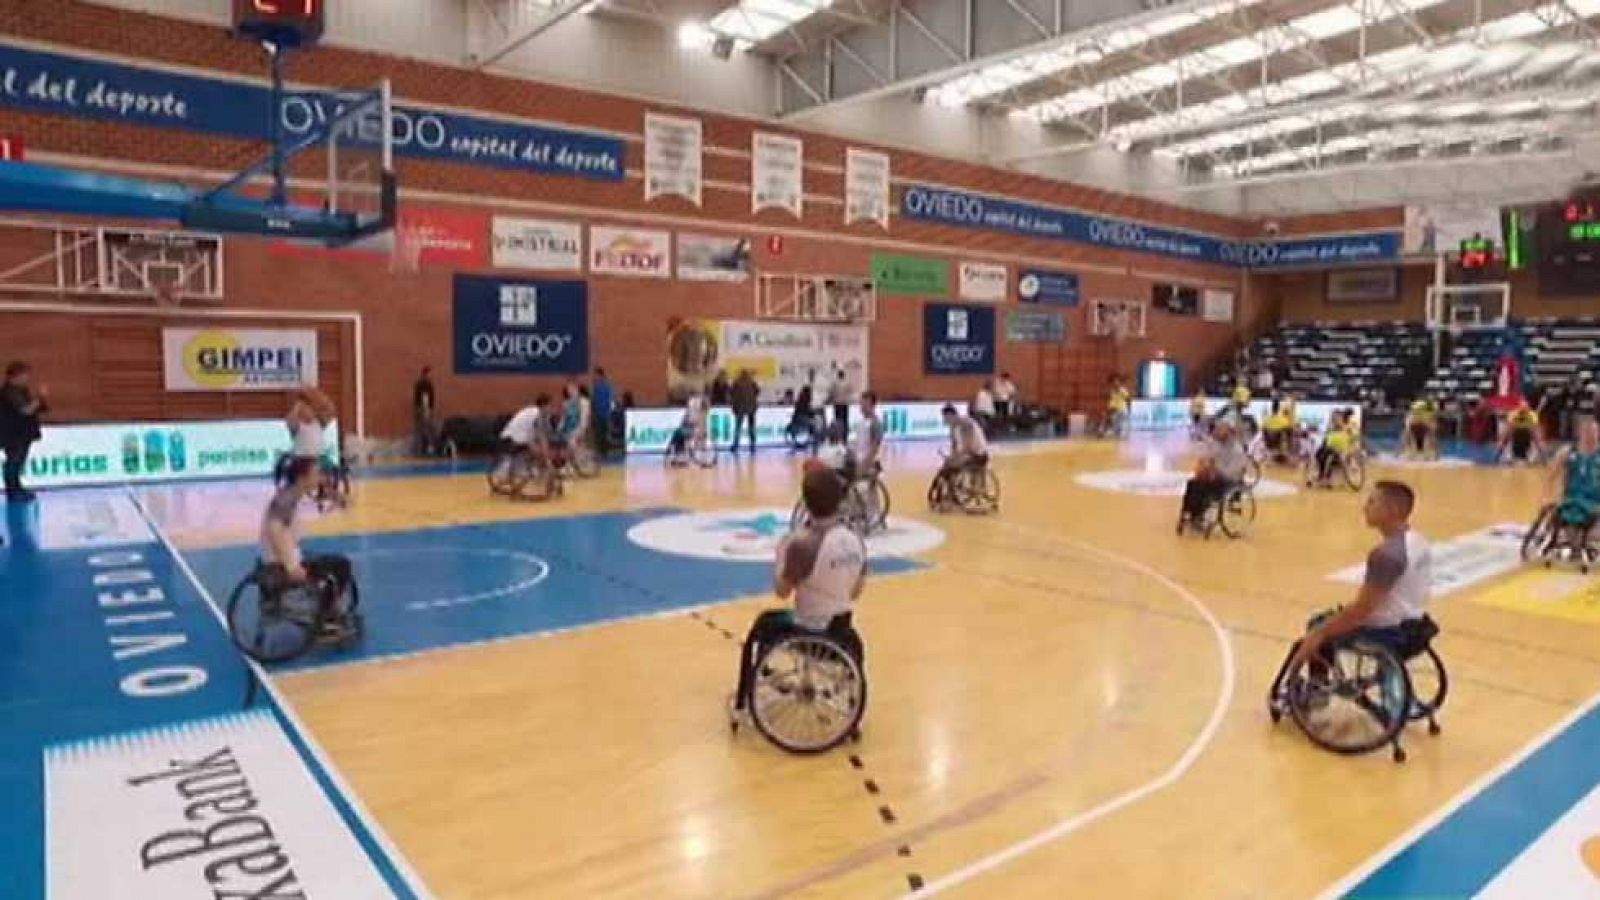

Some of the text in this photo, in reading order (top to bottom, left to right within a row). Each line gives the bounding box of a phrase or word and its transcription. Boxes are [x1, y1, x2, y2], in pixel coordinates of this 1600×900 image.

[28, 73, 76, 104] del
[85, 81, 187, 118] deporte
[452, 135, 517, 160] capital
[521, 140, 551, 165] del
[555, 147, 616, 171] deporte
[906, 188, 983, 223] OVIEDO
[198, 348, 303, 370] GIMPEI
[31, 451, 107, 476] urias
[87, 551, 209, 697] OVIEDO
